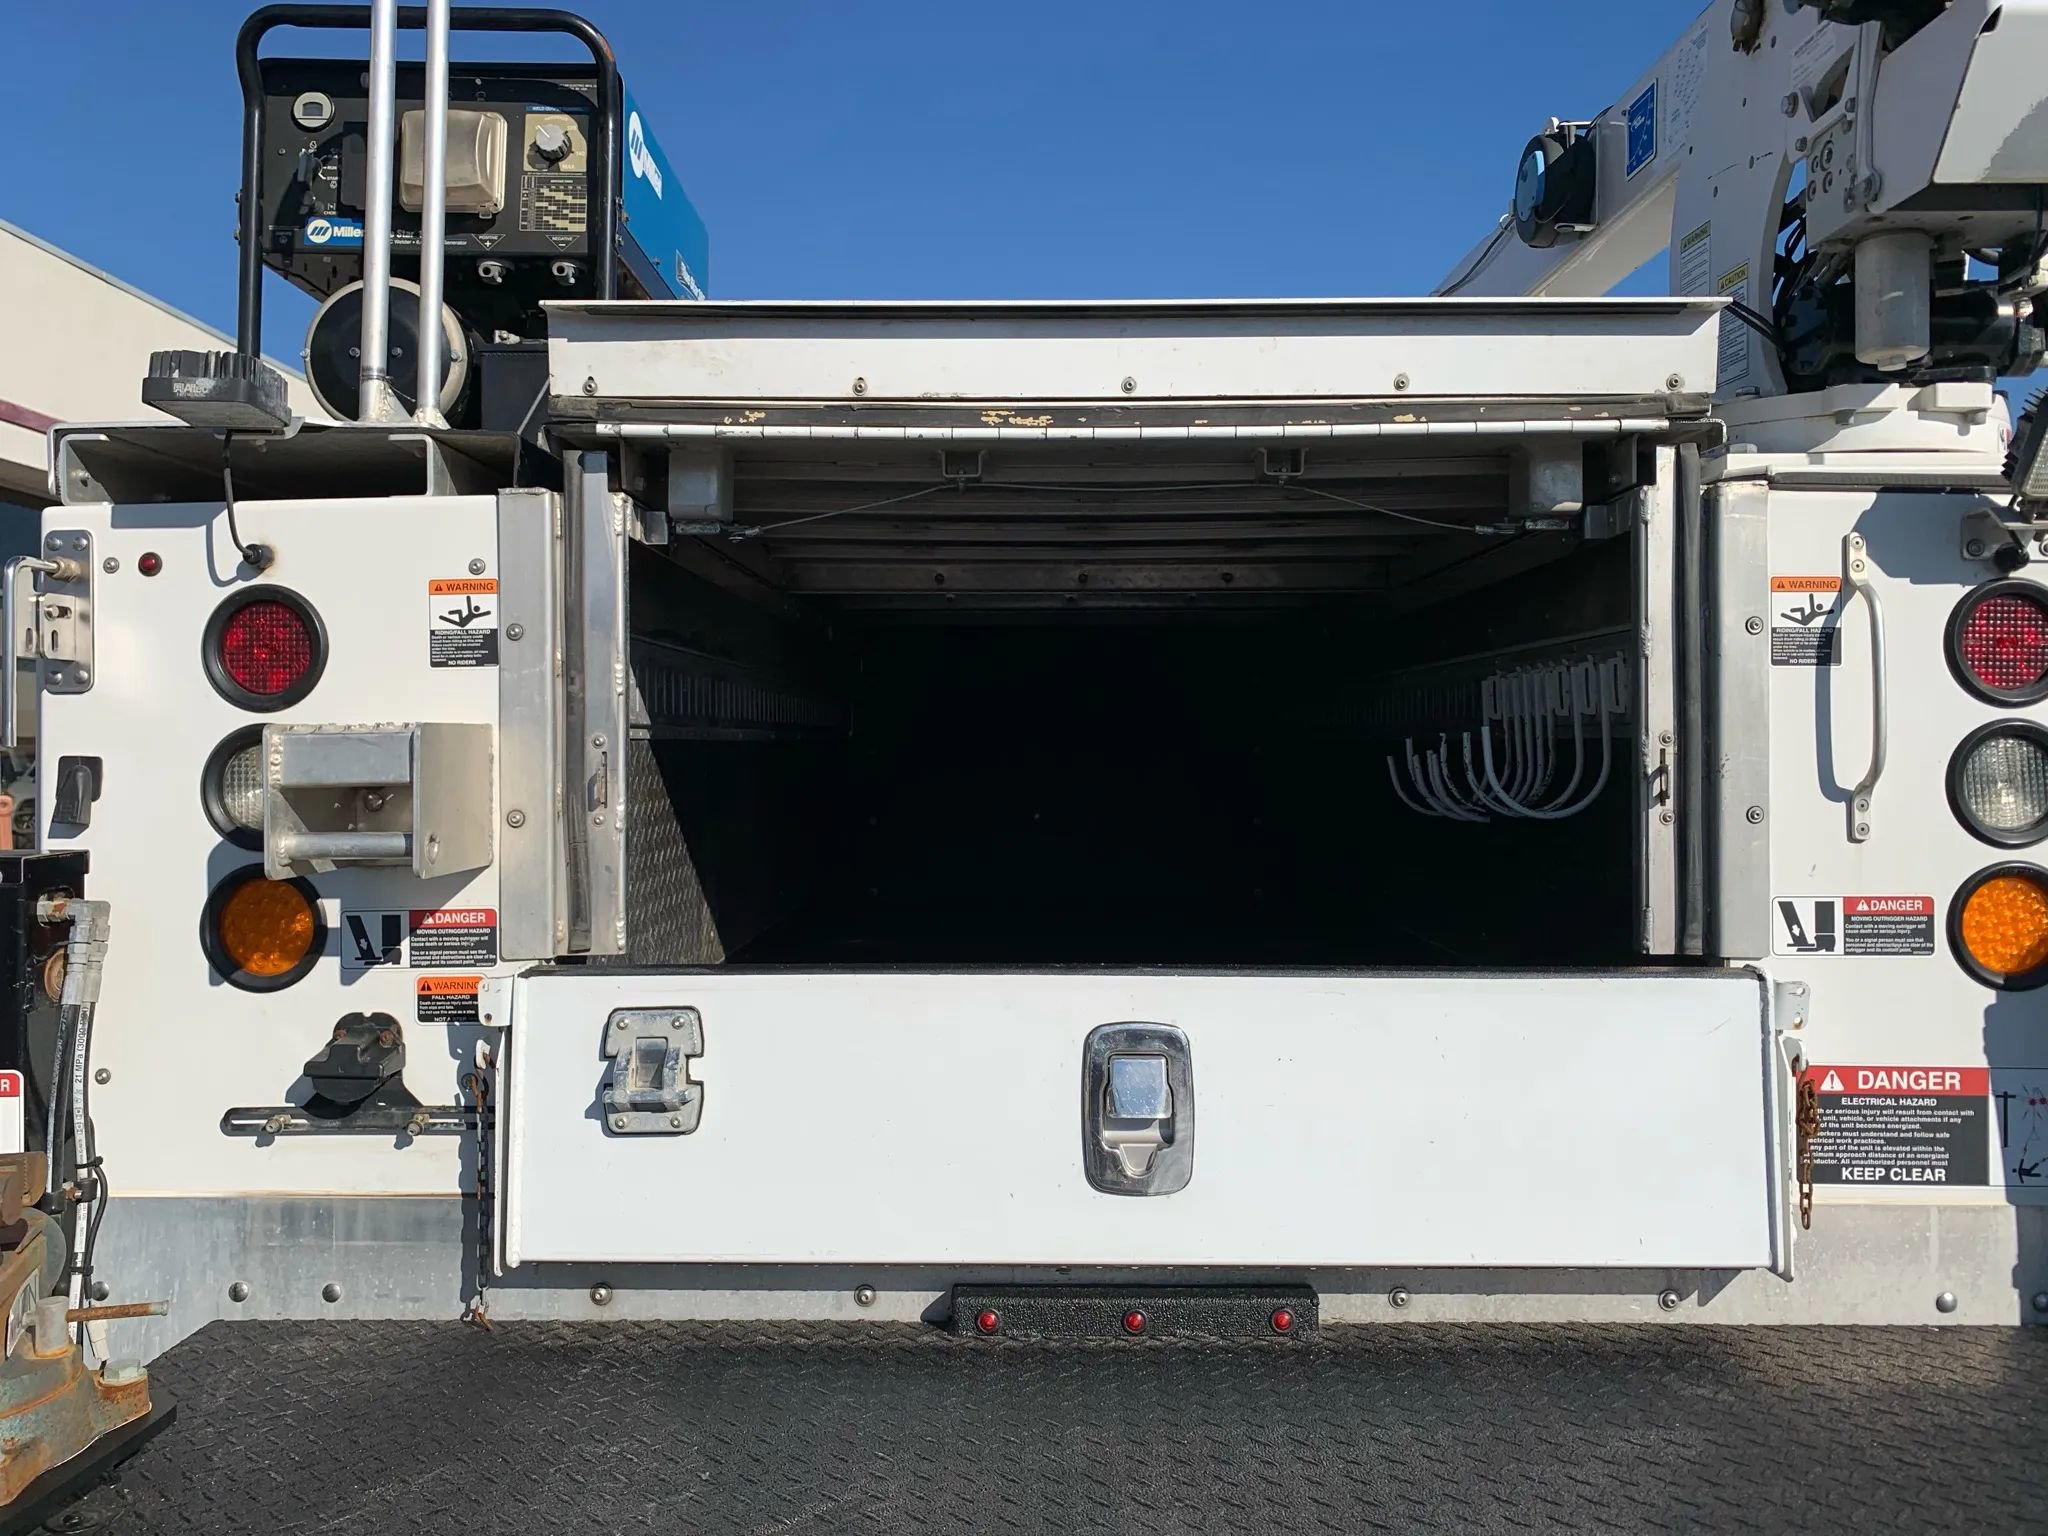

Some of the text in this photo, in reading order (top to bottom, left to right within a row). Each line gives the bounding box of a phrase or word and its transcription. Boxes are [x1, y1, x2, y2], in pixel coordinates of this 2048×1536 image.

[1724, 268, 1746, 288] CAUTION
[446, 583, 494, 591] WARNING
[1789, 580, 1837, 588] WARNING
[1871, 900, 1922, 910] DANGER
[436, 913, 486, 923] DANGER
[75, 1075, 82, 1083] 21
[1858, 1070, 1960, 1090] DANGER
[1842, 1167, 1946, 1181] KEEP CLEAR
